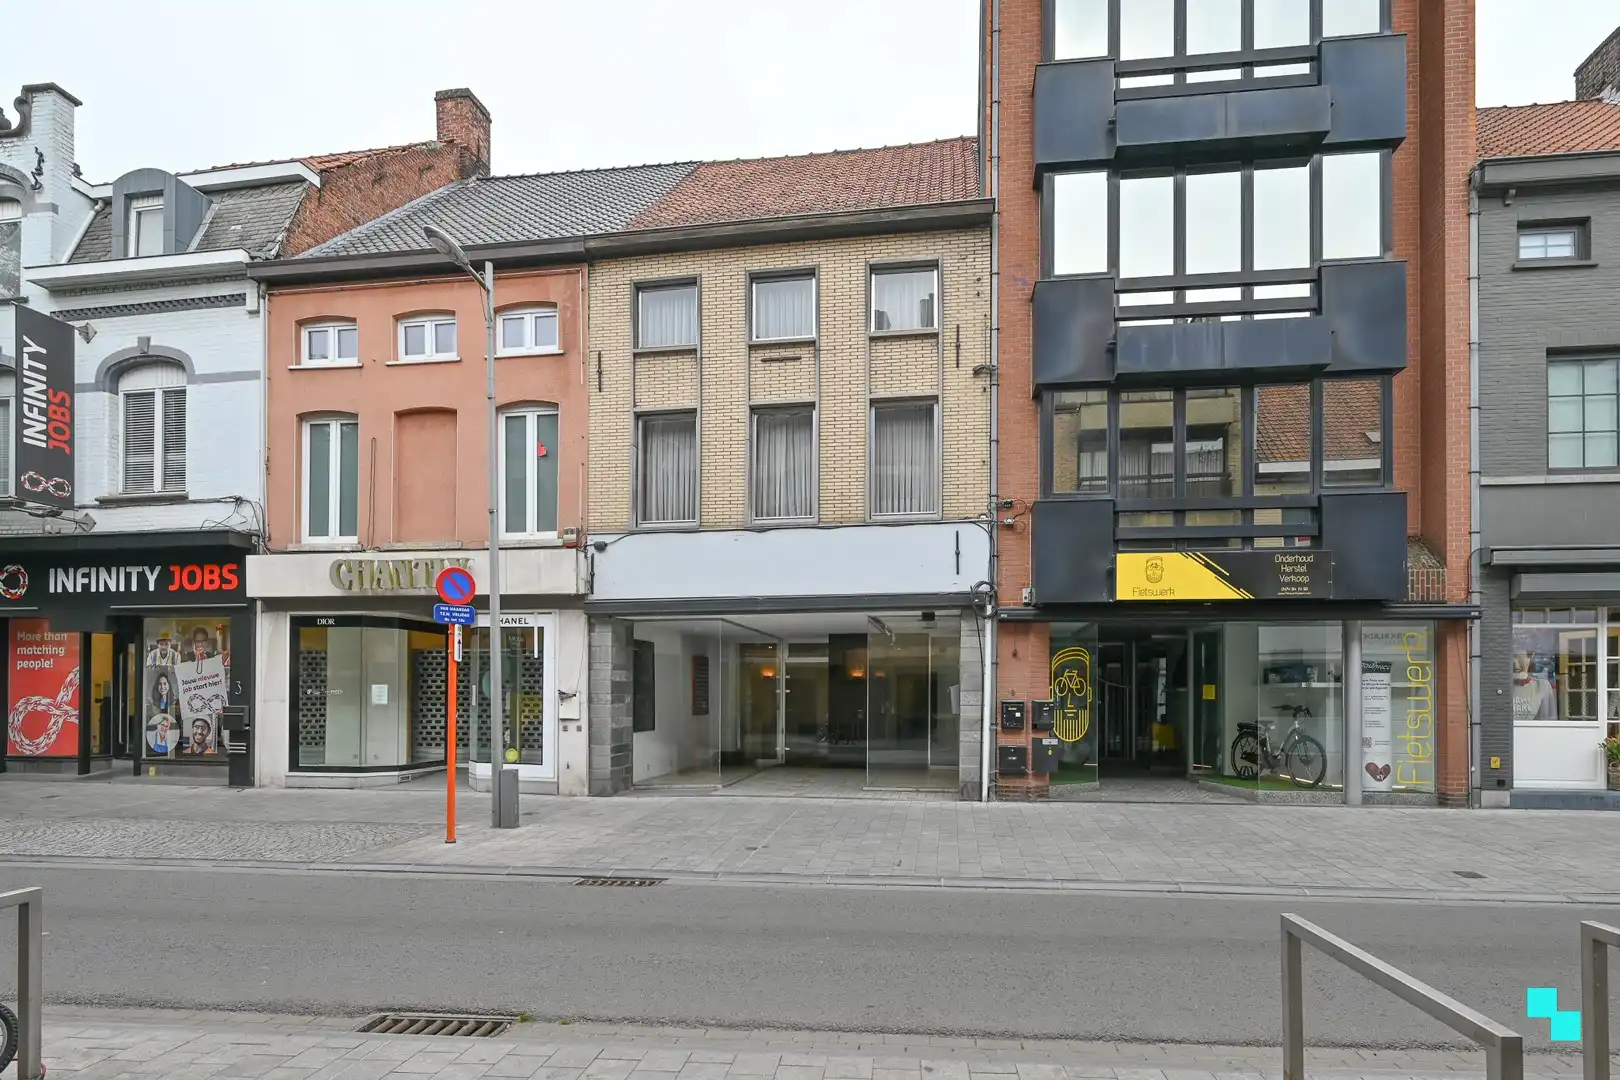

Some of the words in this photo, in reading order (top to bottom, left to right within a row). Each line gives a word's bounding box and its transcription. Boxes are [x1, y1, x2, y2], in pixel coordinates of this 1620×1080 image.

[22, 334, 47, 449] INFINITY
[48, 387, 72, 456] JOBS
[1274, 554, 1314, 563] Onderhoud
[1281, 564, 1307, 573] Herstel
[49, 566, 161, 594] INFINITY
[168, 563, 238, 592] JOBS
[1279, 574, 1310, 584] Verkoop
[1132, 586, 1176, 597] Fietswerk
[500, 617, 529, 625] HANEL
[17, 632, 41, 641] More
[44, 632, 67, 641] than
[17, 645, 65, 657] matching
[17, 658, 53, 671] people!
[198, 673, 220, 682] nieuwe
[183, 686, 193, 694] job
[193, 683, 208, 691] start
[235, 680, 242, 695] 3
[1397, 631, 1432, 785] Fietswerk
